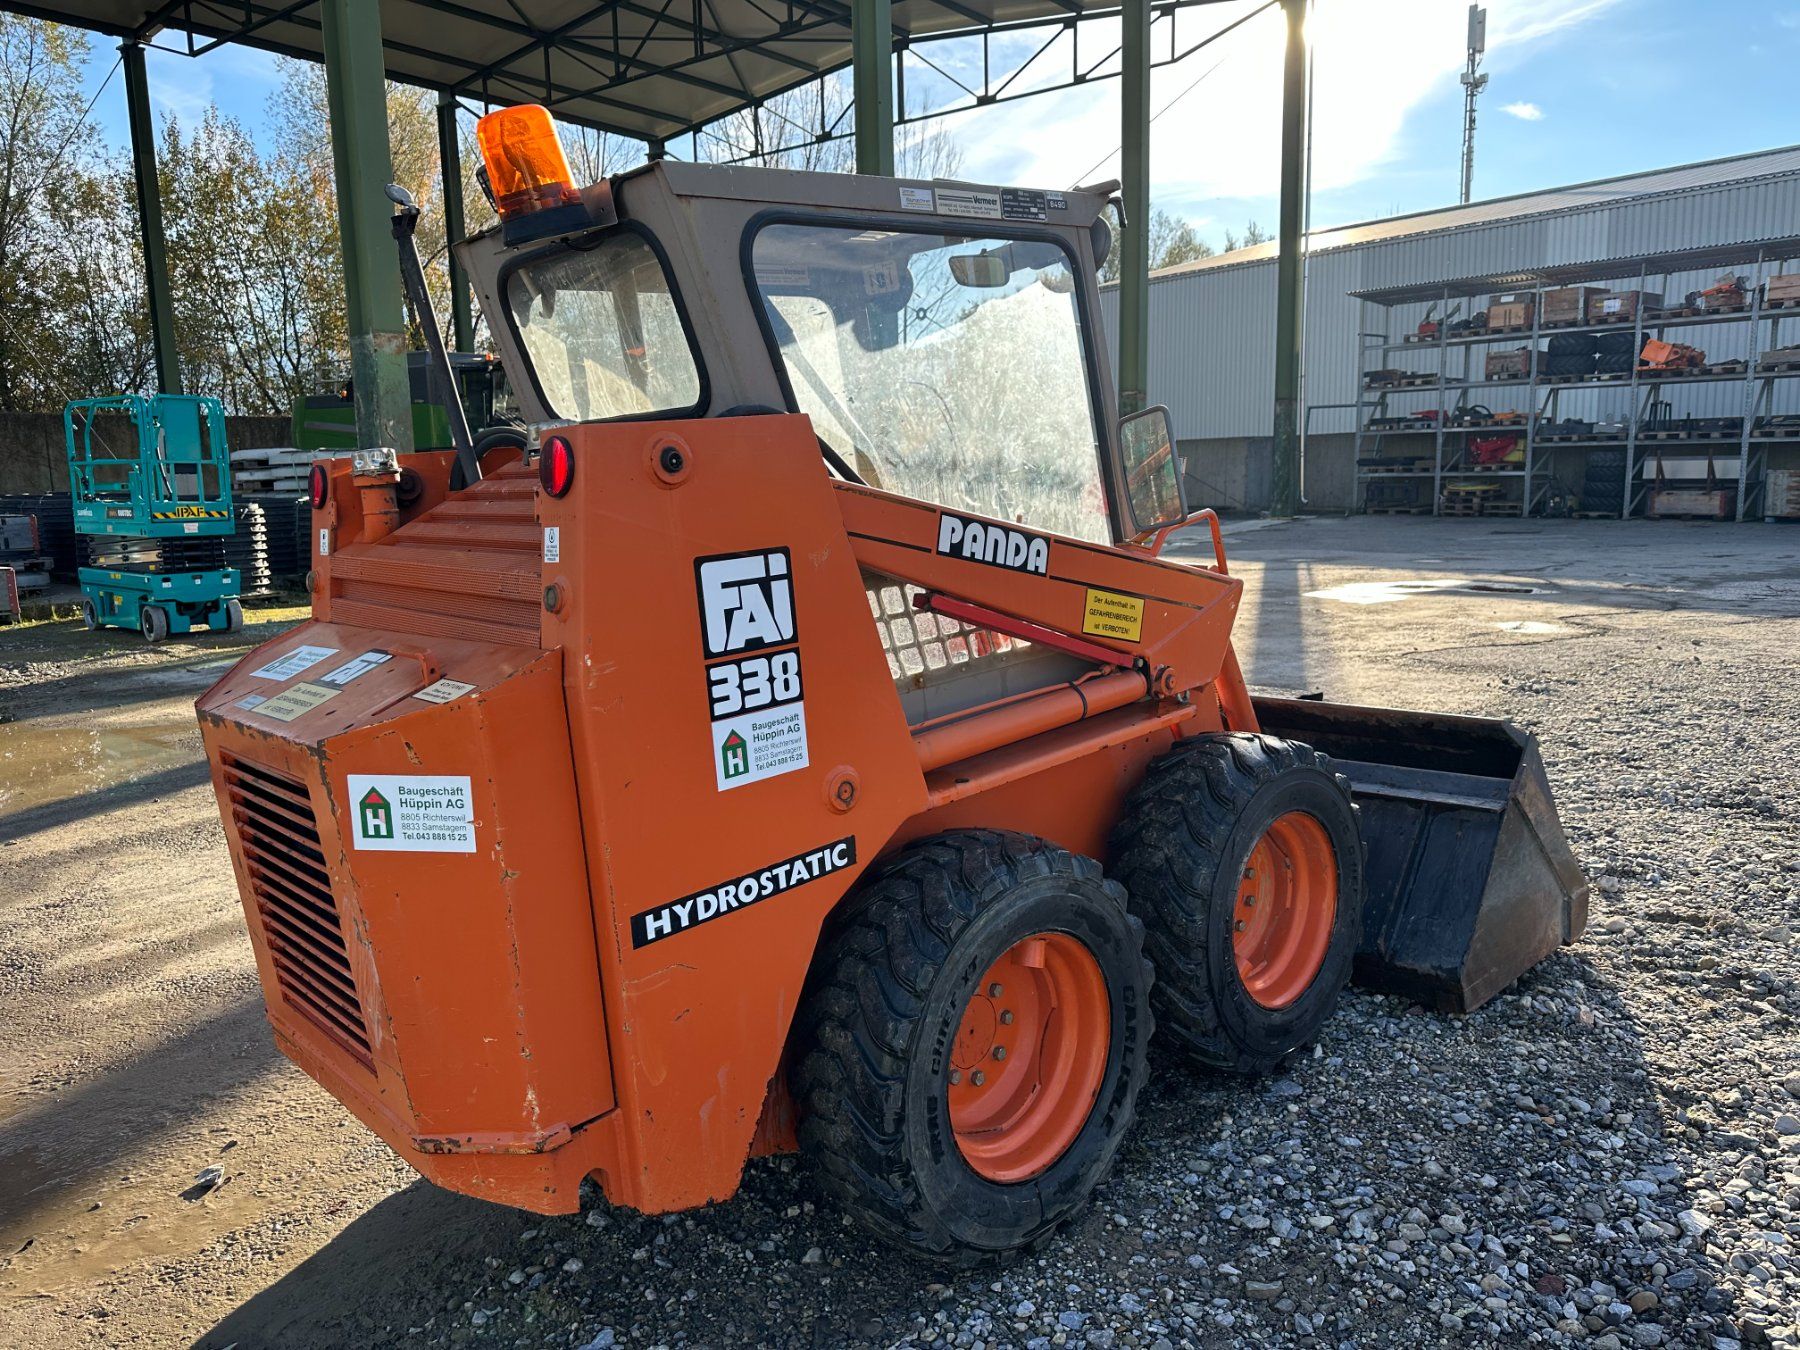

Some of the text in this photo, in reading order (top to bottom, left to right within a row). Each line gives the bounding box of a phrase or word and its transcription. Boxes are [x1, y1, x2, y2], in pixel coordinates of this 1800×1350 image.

[973, 195, 997, 205] Vermeer
[176, 506, 205, 517] IPAF
[938, 515, 1048, 573] PANDA
[1089, 608, 1137, 623] GEFAHRENBEREICH
[709, 652, 800, 716] 338
[752, 713, 799, 731] Baugeschäft
[753, 723, 800, 742] Hüppin AG
[398, 786, 464, 797] Baugeschäft
[400, 798, 464, 810] Hüppin AG
[401, 813, 466, 822] 8805 Richterswil
[401, 823, 420, 831] 8833
[432, 833, 446, 841] 888
[448, 833, 456, 841] 15
[645, 843, 848, 940] HYDROSTATIC
[932, 992, 958, 1076] CHIEF
